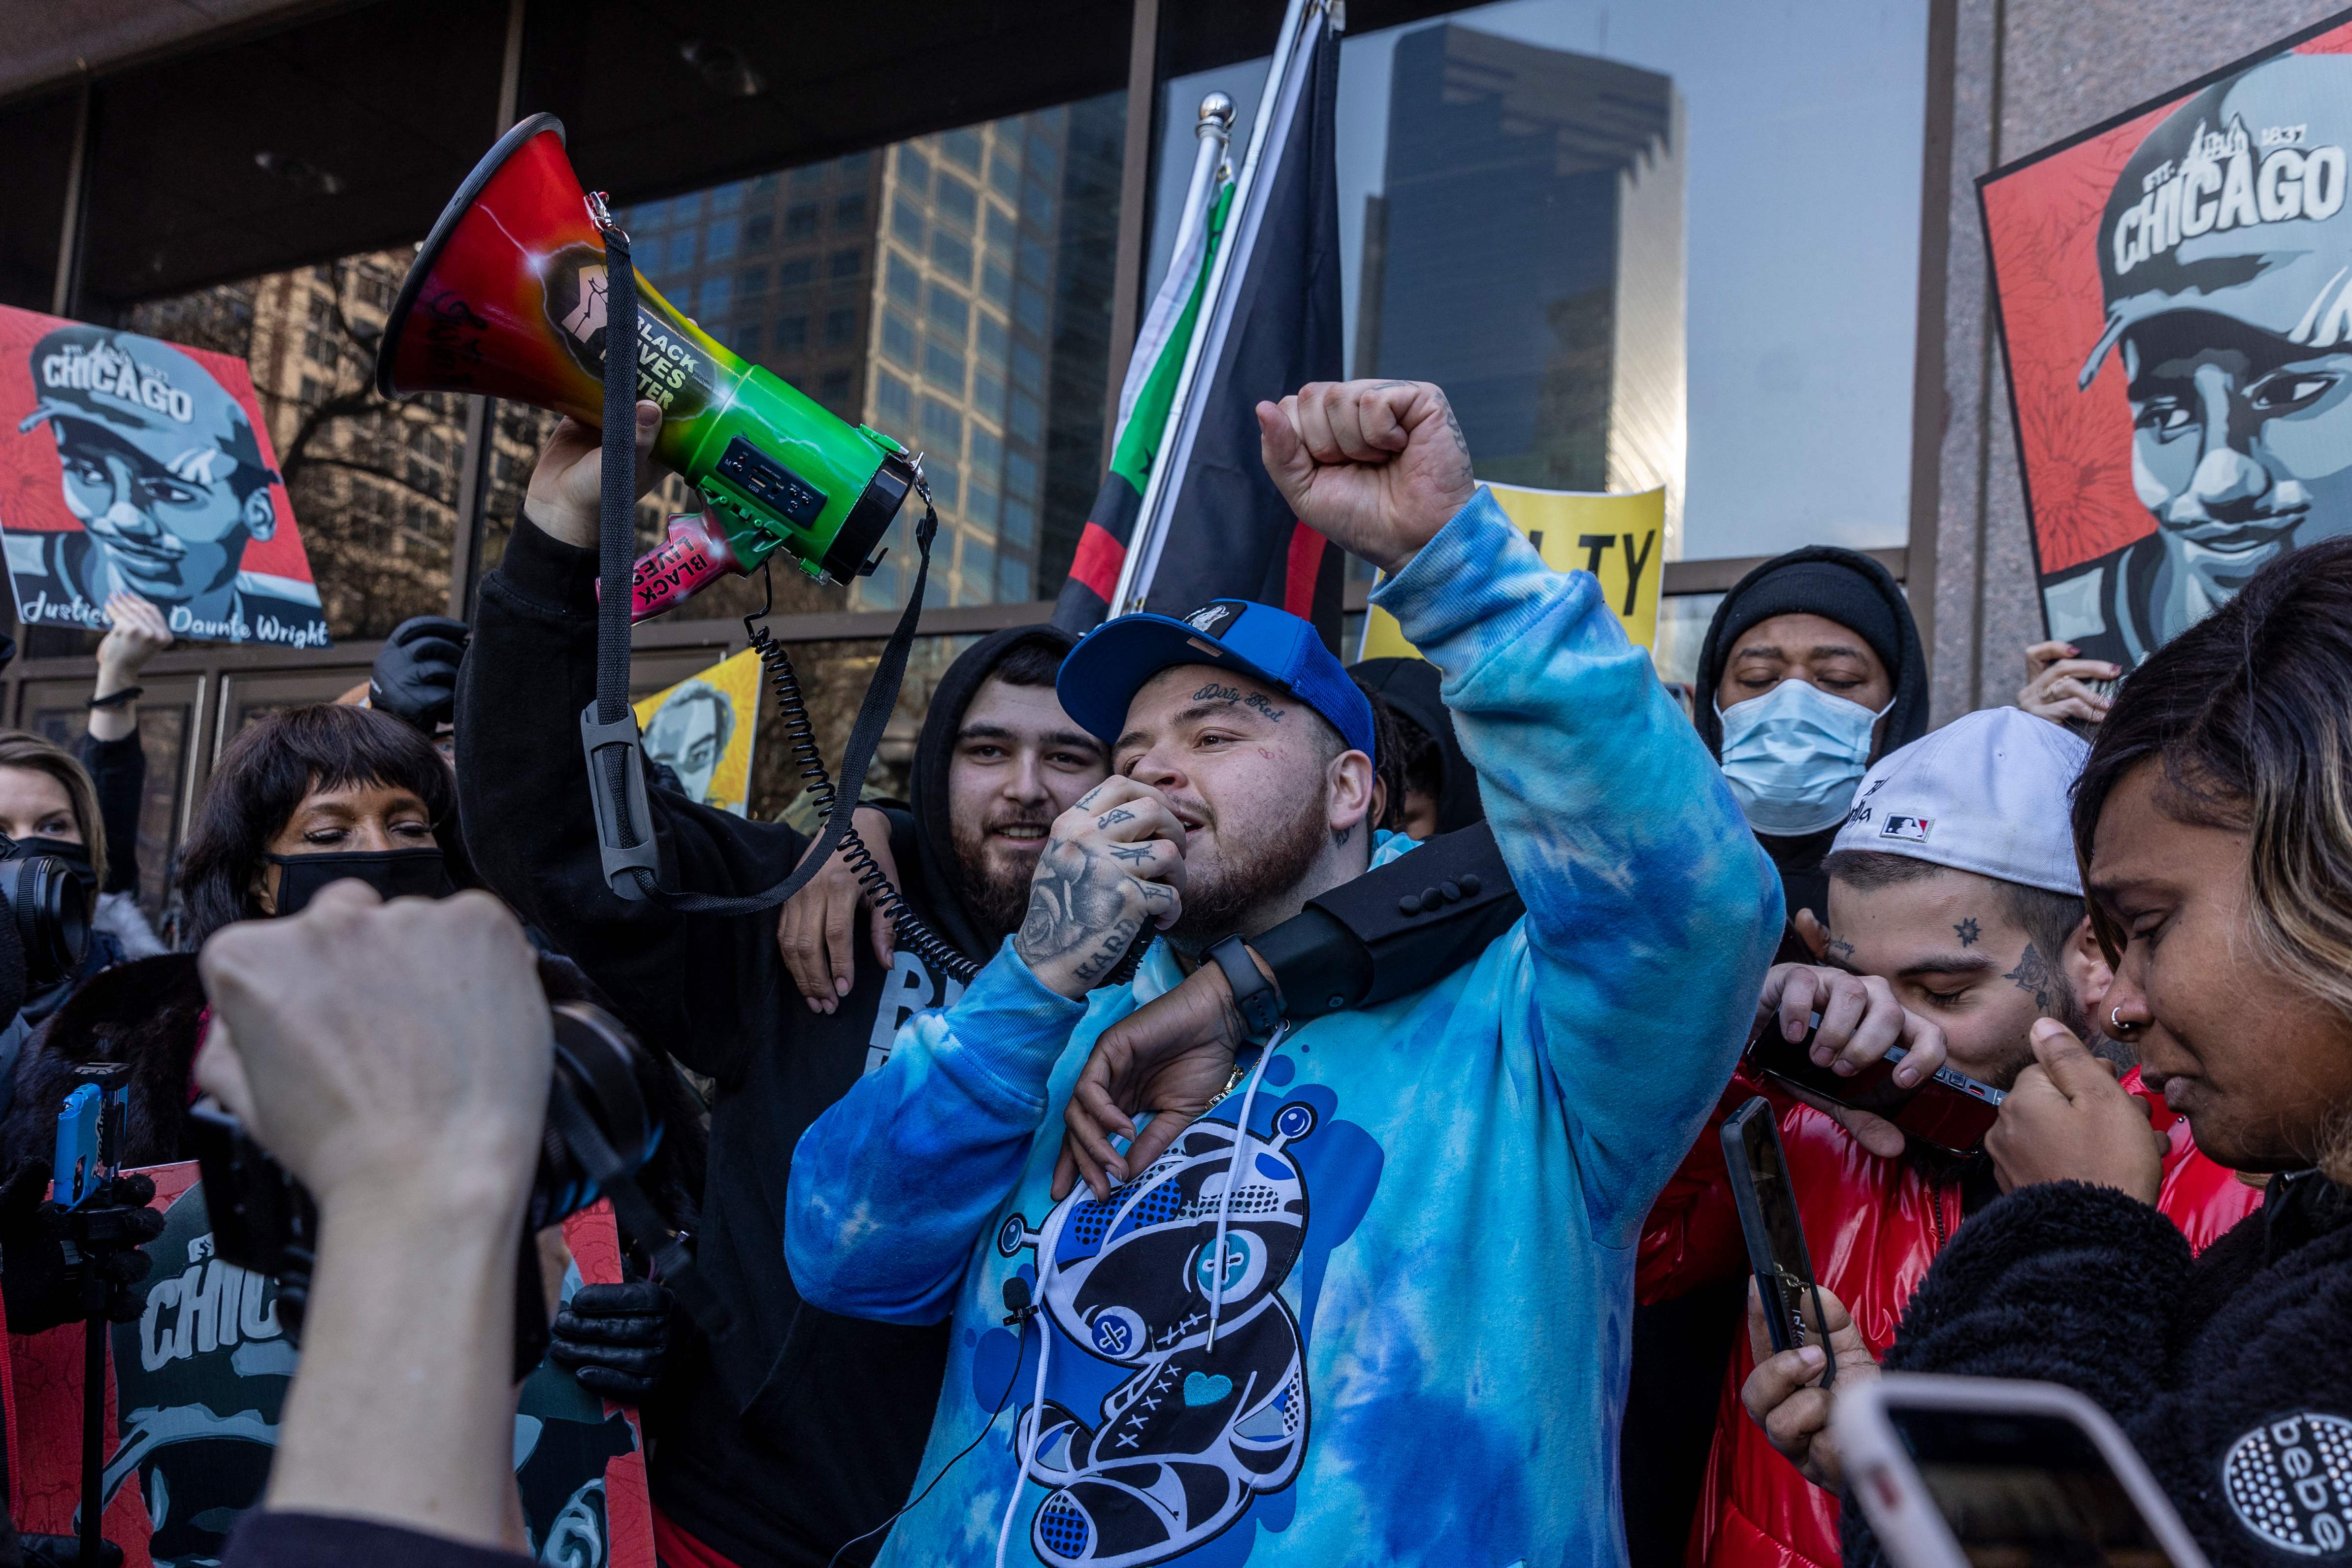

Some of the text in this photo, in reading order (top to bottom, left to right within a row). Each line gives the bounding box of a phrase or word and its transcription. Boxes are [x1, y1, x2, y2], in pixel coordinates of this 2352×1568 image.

[2113, 145, 2347, 275] CHICAGO
[42, 351, 194, 423] CHICAGO
[748, 484, 759, 493] USB
[637, 554, 708, 606] BLACK
[168, 605, 252, 639] Daunte
[255, 614, 328, 650] Wright
[1193, 683, 1285, 723] Dirty Red
[140, 1258, 283, 1372] CHIC
[2270, 1415, 2346, 1552] bebe
